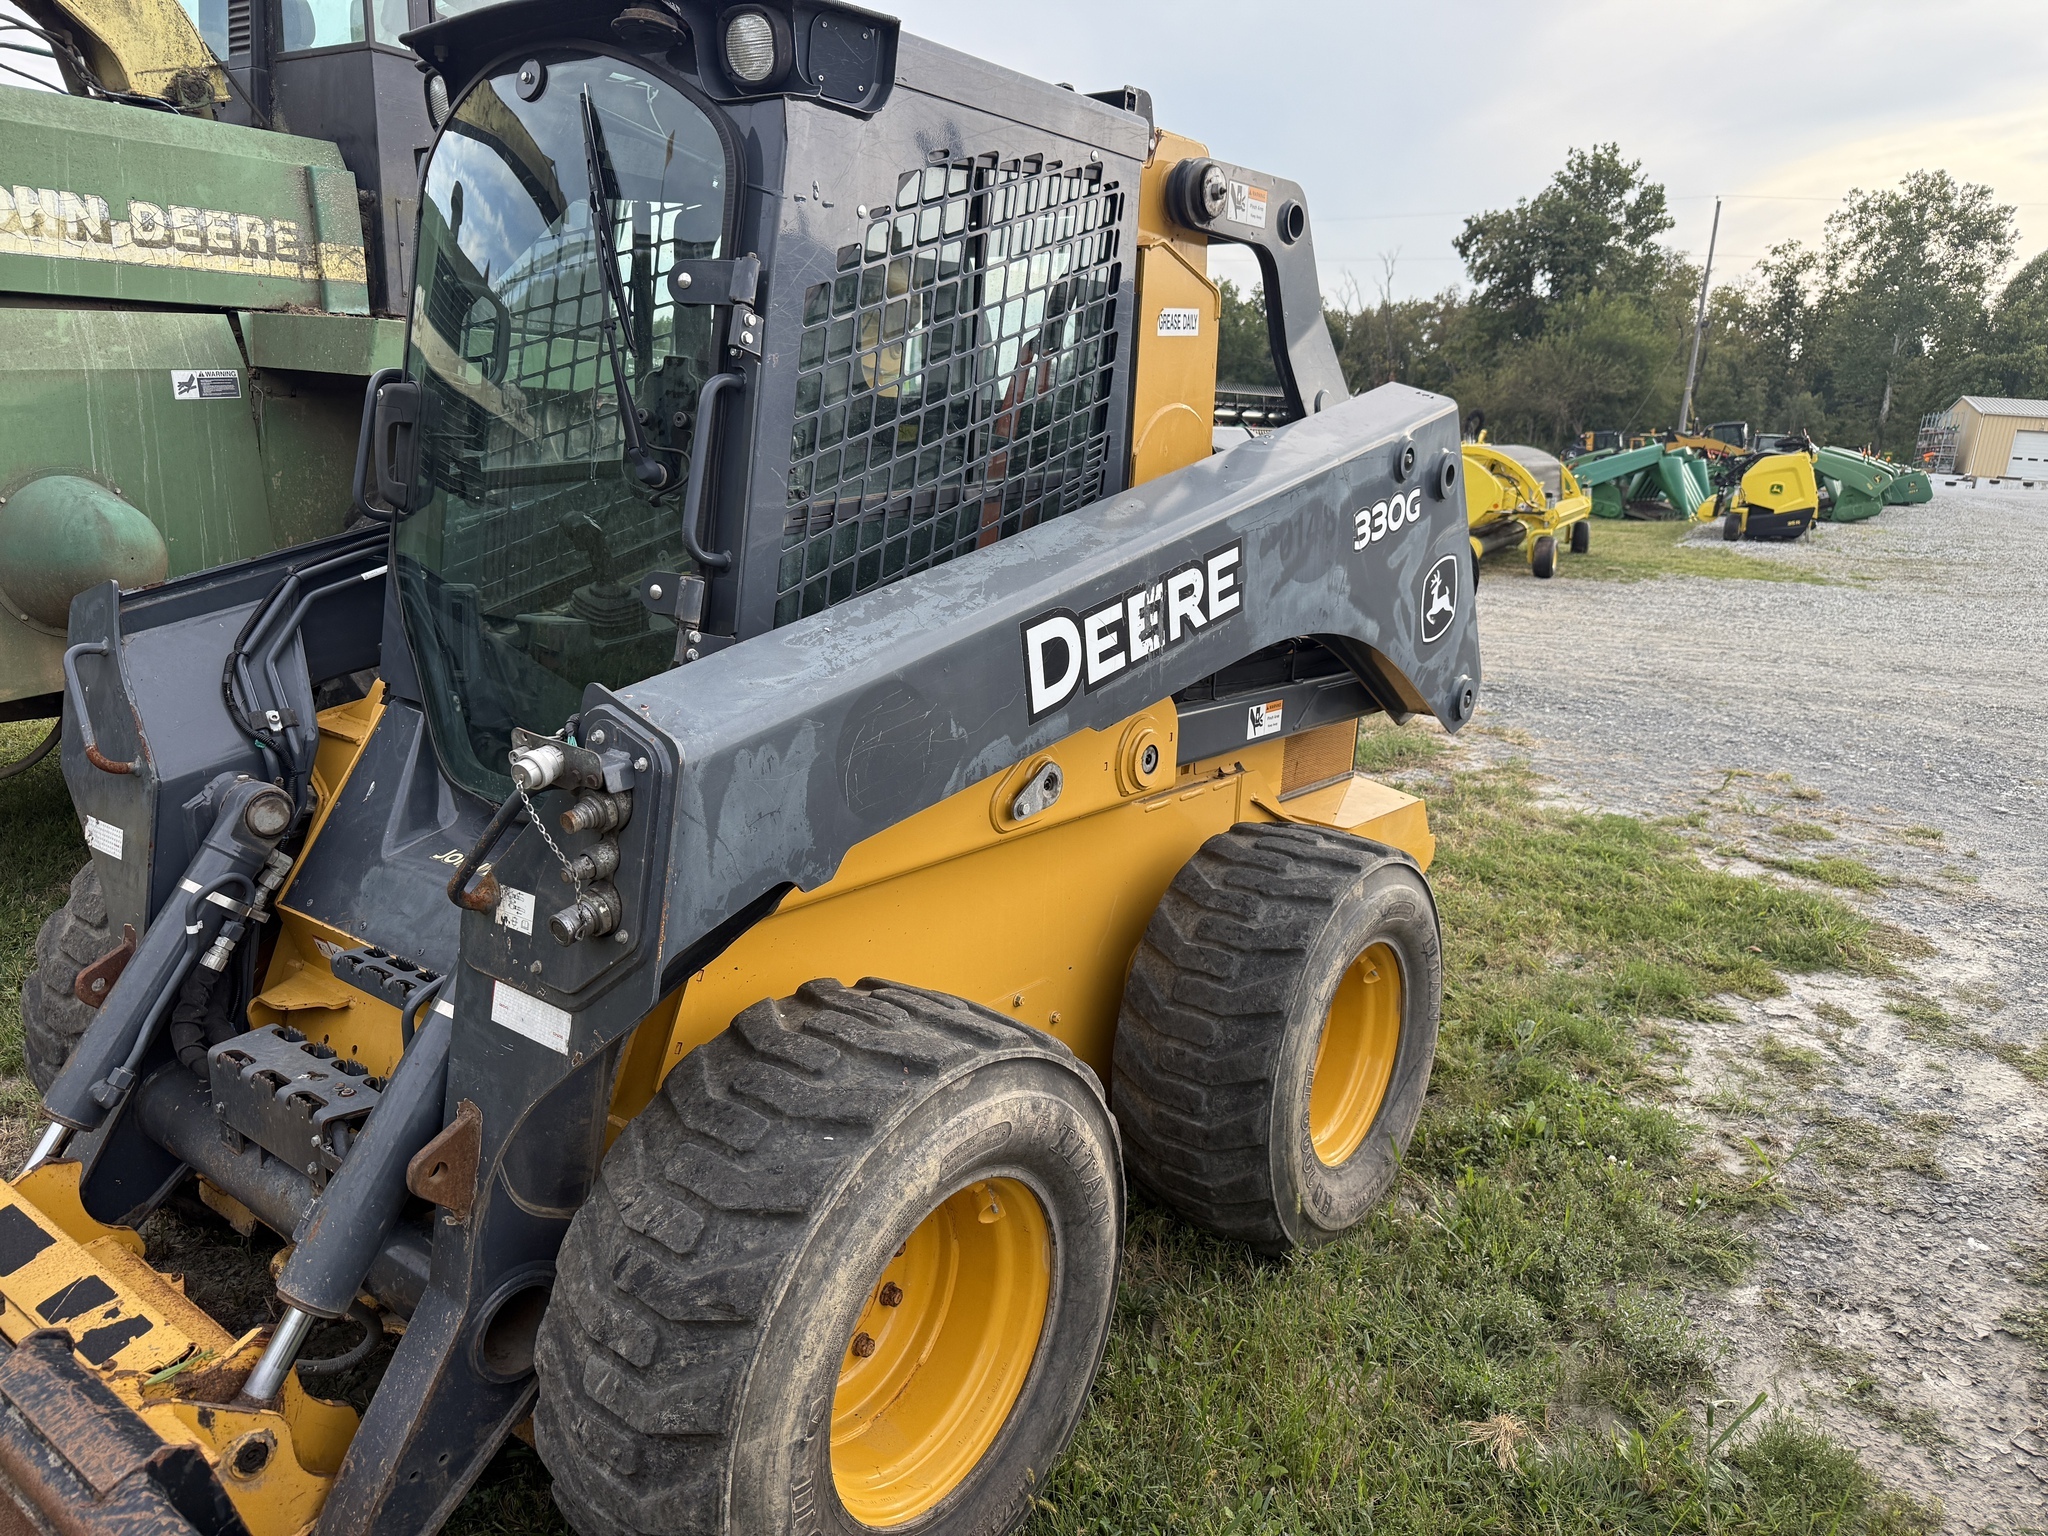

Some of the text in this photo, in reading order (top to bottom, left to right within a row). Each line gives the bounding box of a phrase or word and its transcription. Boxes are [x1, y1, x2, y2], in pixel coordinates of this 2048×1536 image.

[127, 199, 300, 261] DEERE
[1158, 313, 1198, 330] GREASE DAILY
[1353, 487, 1421, 552] 330G
[1026, 546, 1241, 714] DEERE
[1049, 1123, 1110, 1227] TITAN
